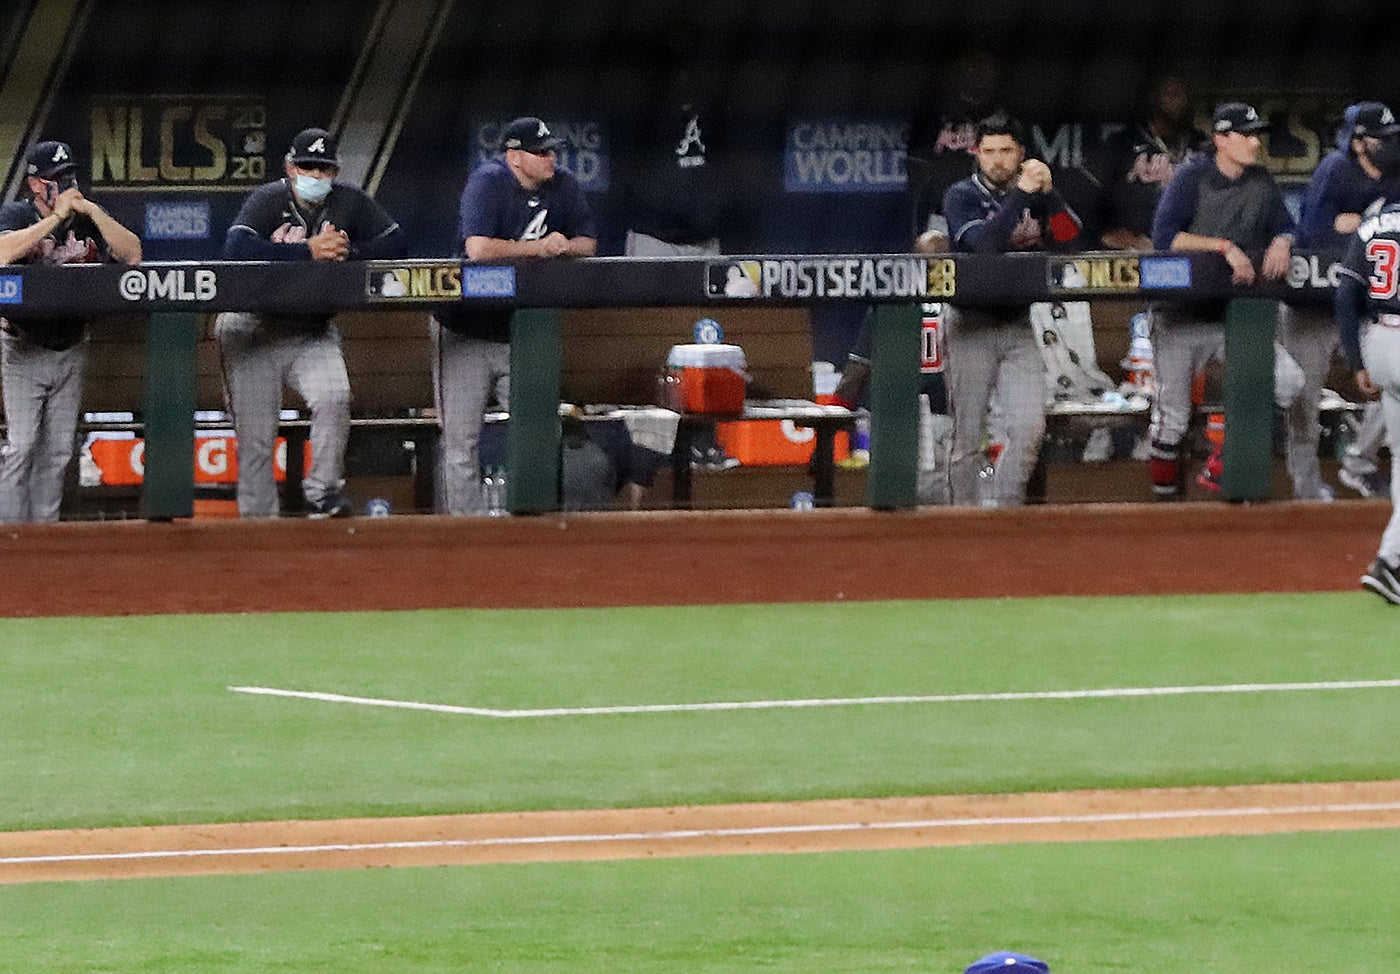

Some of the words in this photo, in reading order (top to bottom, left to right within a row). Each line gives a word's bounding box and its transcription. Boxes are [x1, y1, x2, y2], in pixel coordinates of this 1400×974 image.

[90, 106, 228, 182] NLCS
[232, 156, 265, 180] 20
[119, 269, 217, 301] @MLB
[410, 267, 461, 297] NLCS
[761, 259, 927, 297] POSTSEASON
[198, 439, 228, 475] G
